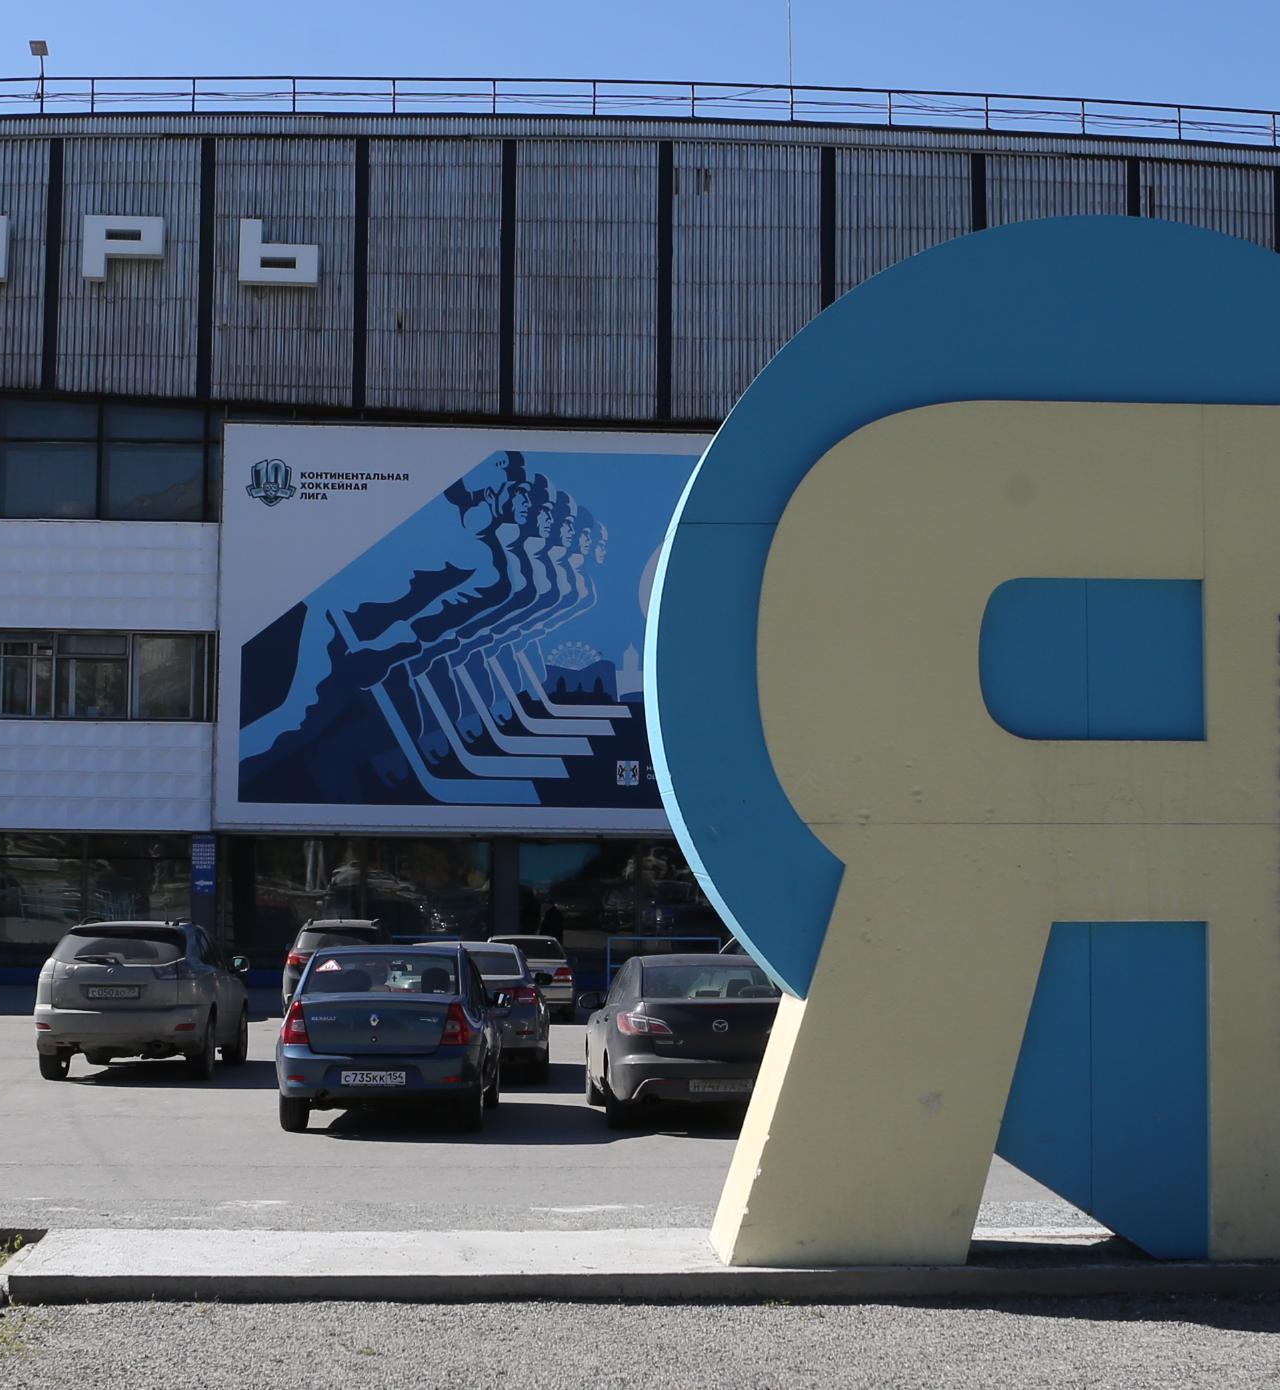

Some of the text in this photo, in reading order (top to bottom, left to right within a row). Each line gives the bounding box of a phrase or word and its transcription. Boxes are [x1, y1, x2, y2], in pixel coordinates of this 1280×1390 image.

[300, 471, 410, 482] КОНТИНЕНТАЛЬНАЯ
[300, 481, 368, 491] ХОККЕЙНАЯ
[300, 492, 328, 501] ЛИГА
[344, 1073, 404, 1083] С735КК 154
